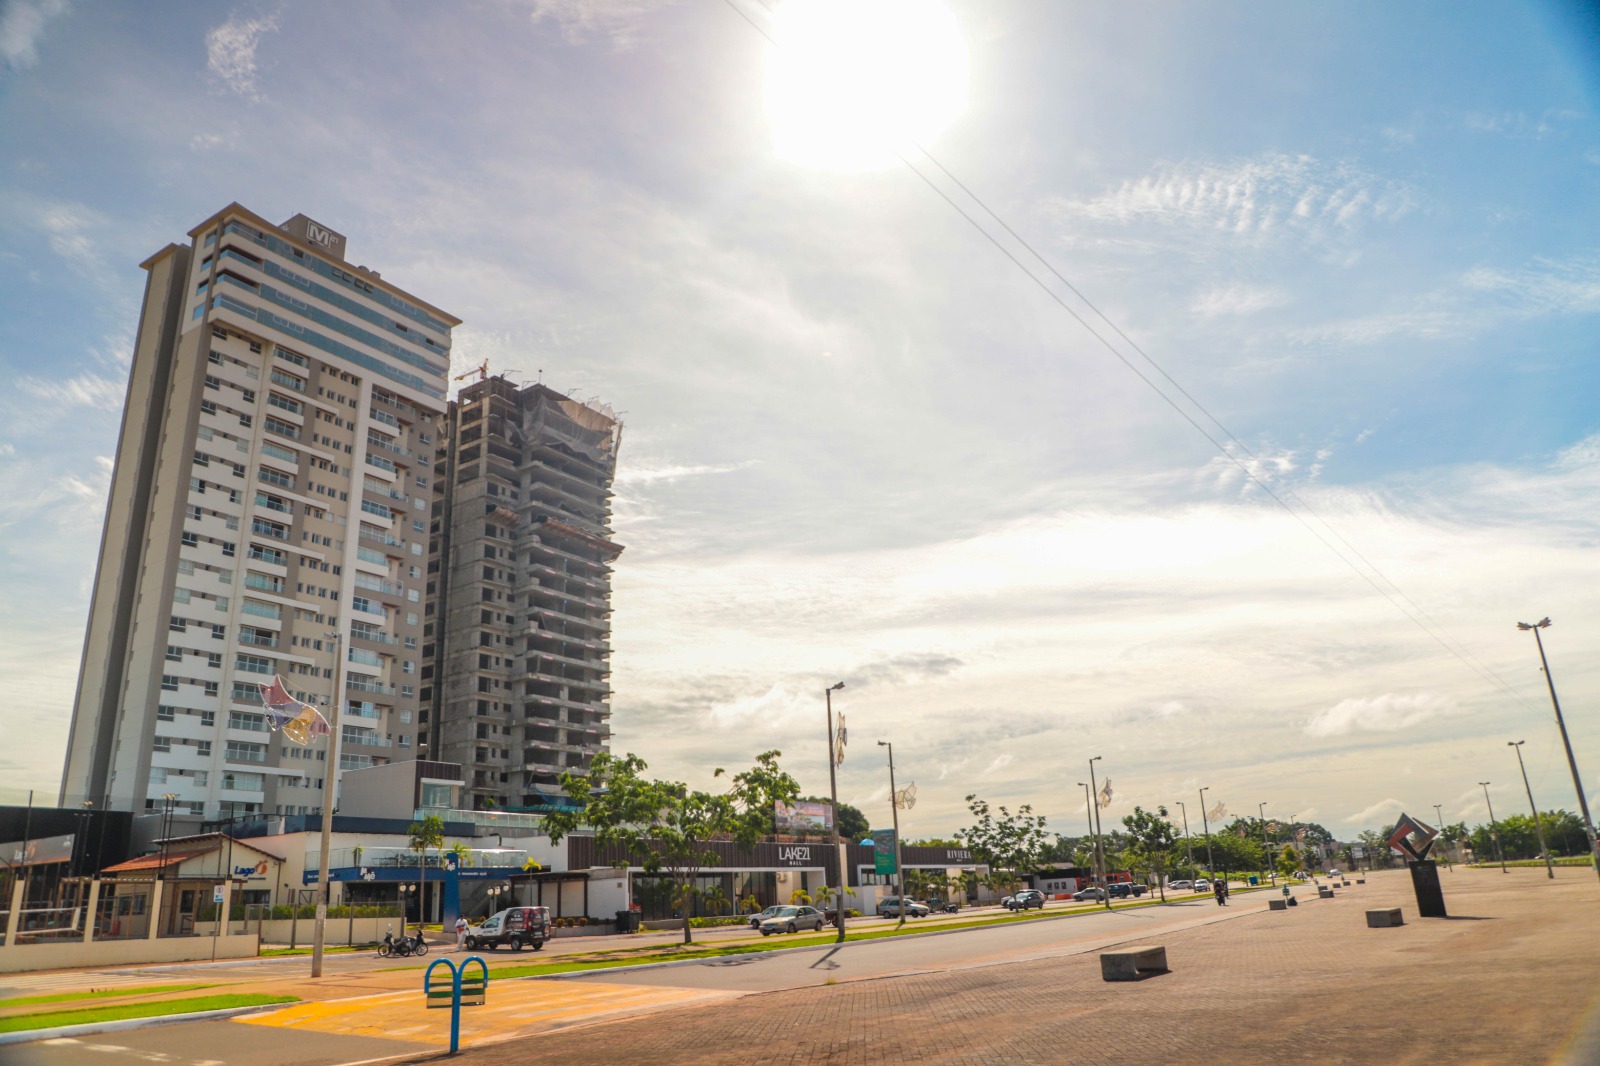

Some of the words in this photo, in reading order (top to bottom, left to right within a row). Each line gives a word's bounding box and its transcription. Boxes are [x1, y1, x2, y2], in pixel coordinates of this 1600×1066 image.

[779, 846, 811, 860] LAKE21
[946, 849, 971, 859] RIVIERA
[234, 865, 255, 877] Lago
